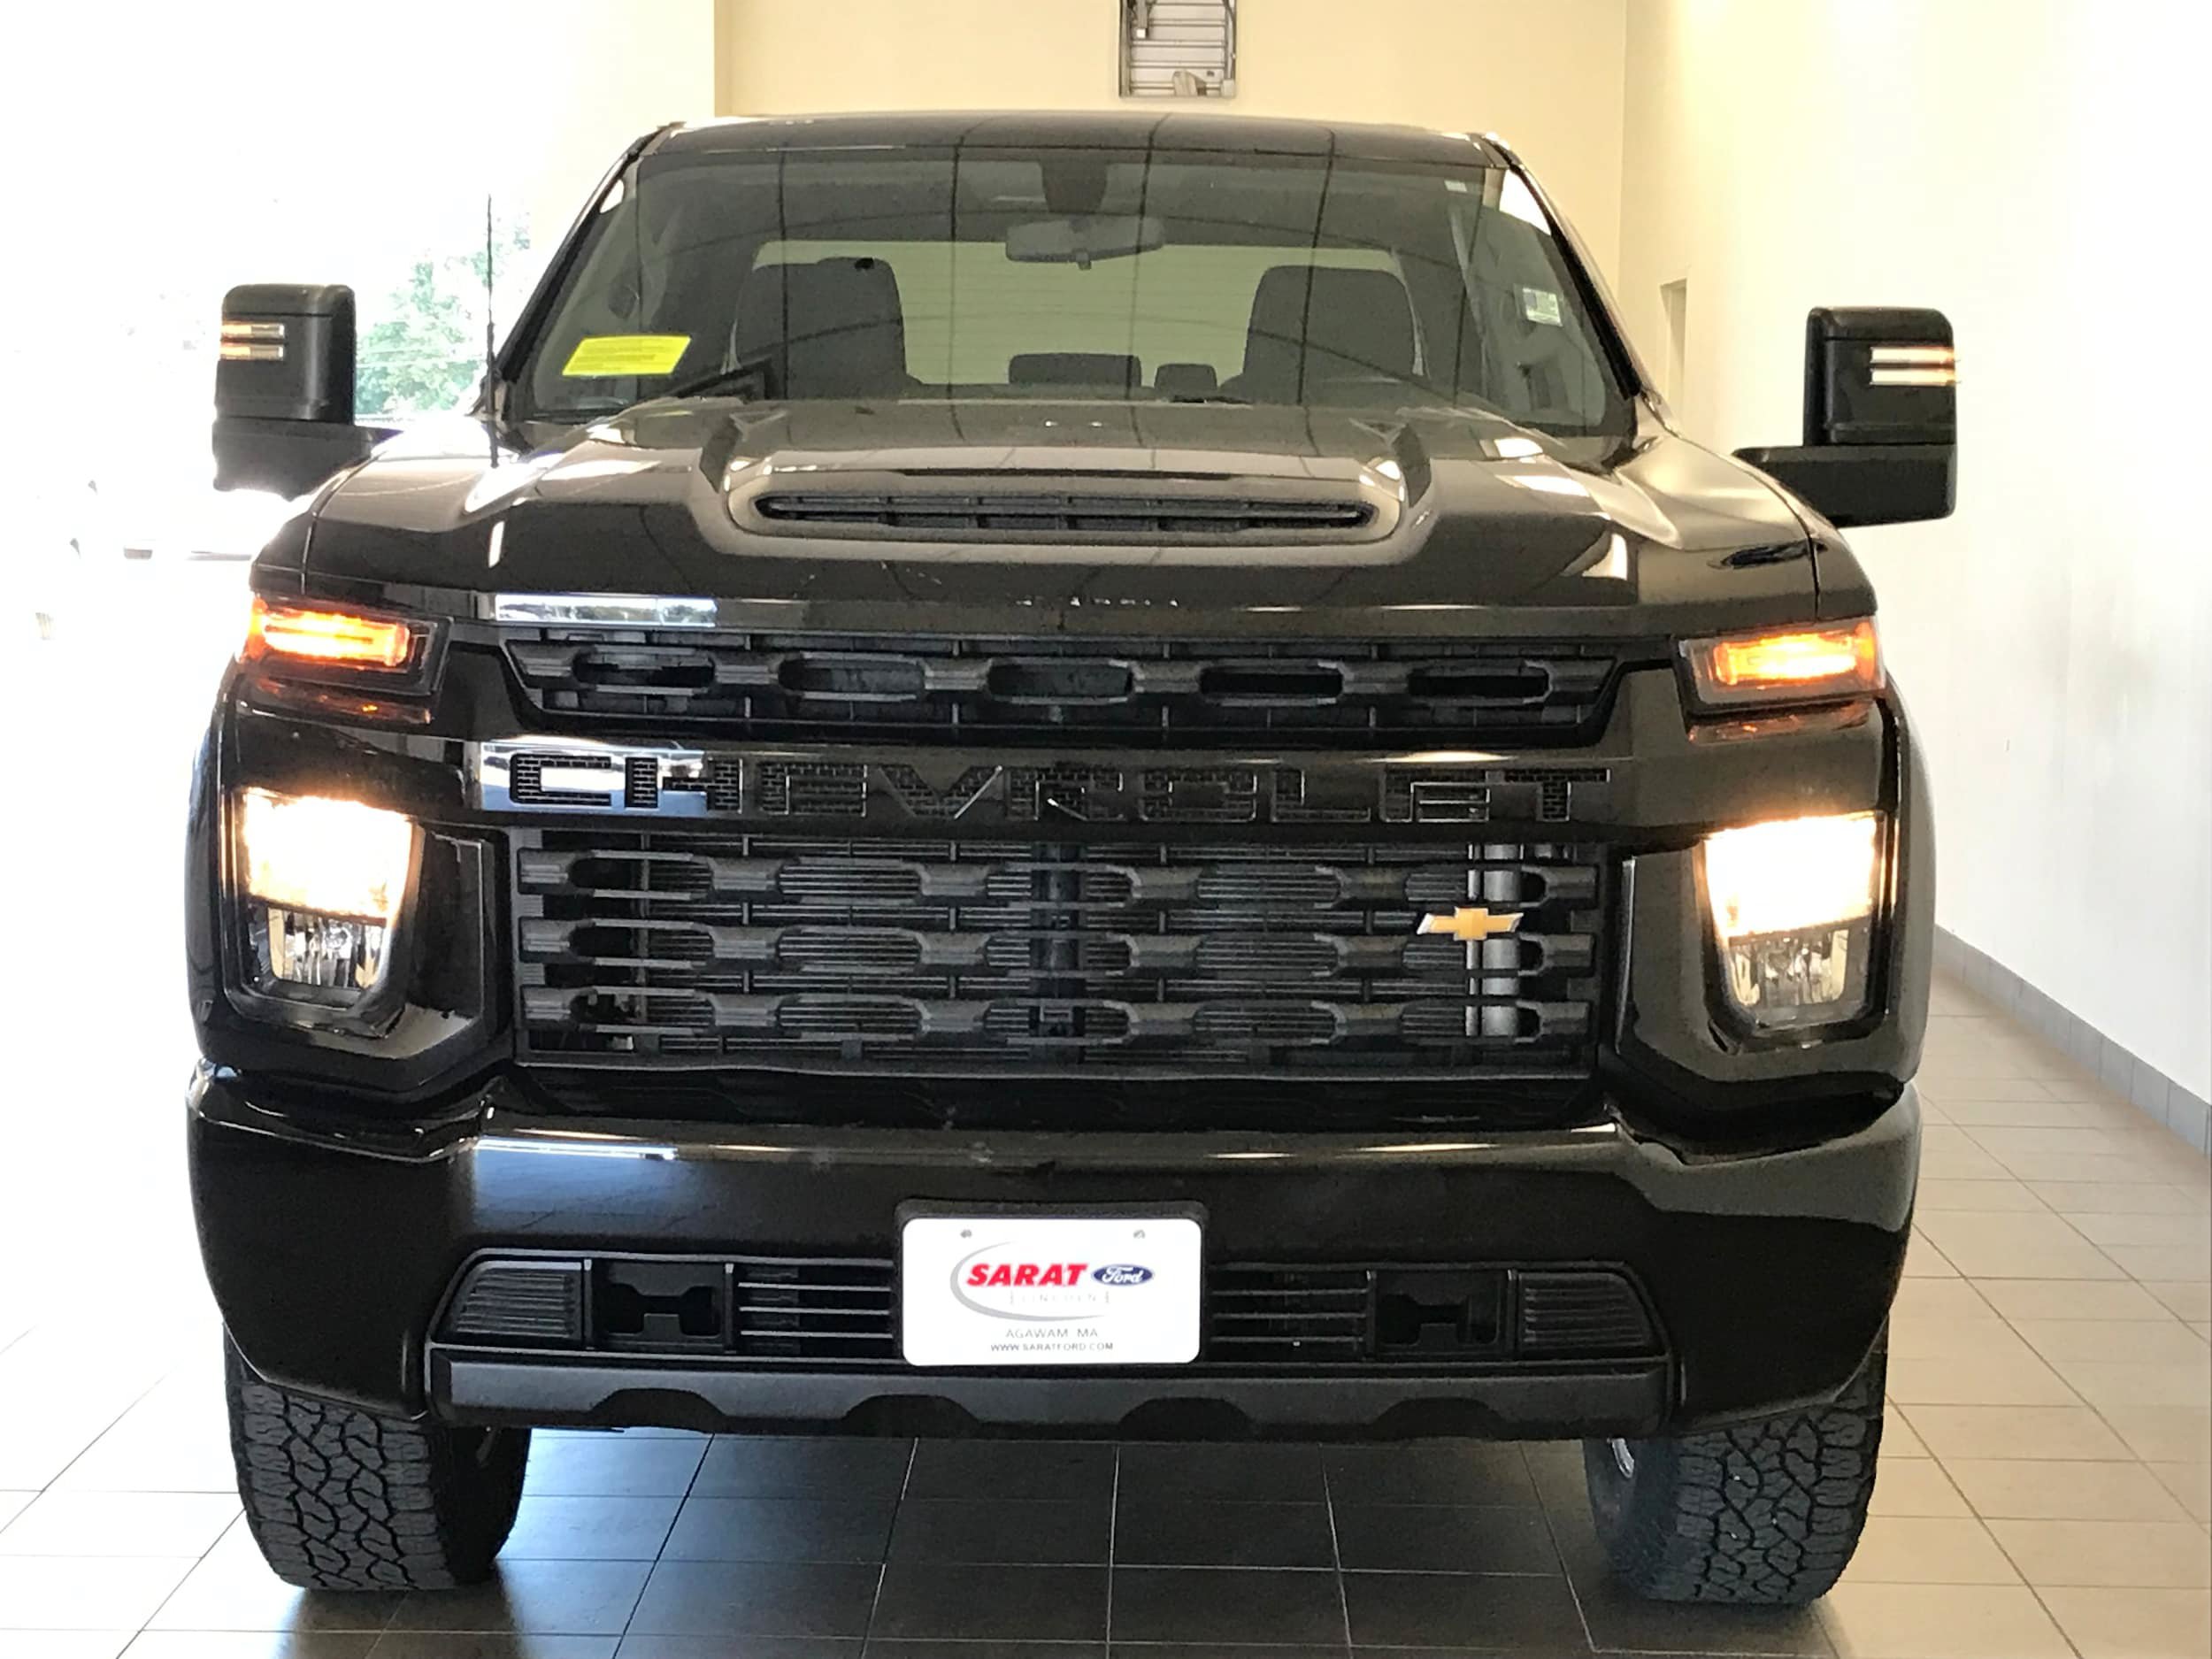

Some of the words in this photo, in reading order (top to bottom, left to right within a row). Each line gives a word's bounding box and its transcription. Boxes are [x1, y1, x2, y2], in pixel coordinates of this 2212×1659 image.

[510, 752, 1610, 823] CHEVROLET
[966, 1263, 1089, 1286] SARAT
[1102, 1265, 1144, 1284] Ford
[1077, 1328, 1099, 1338] MA
[990, 1342, 1114, 1352] WWWSARATFORDCOM
